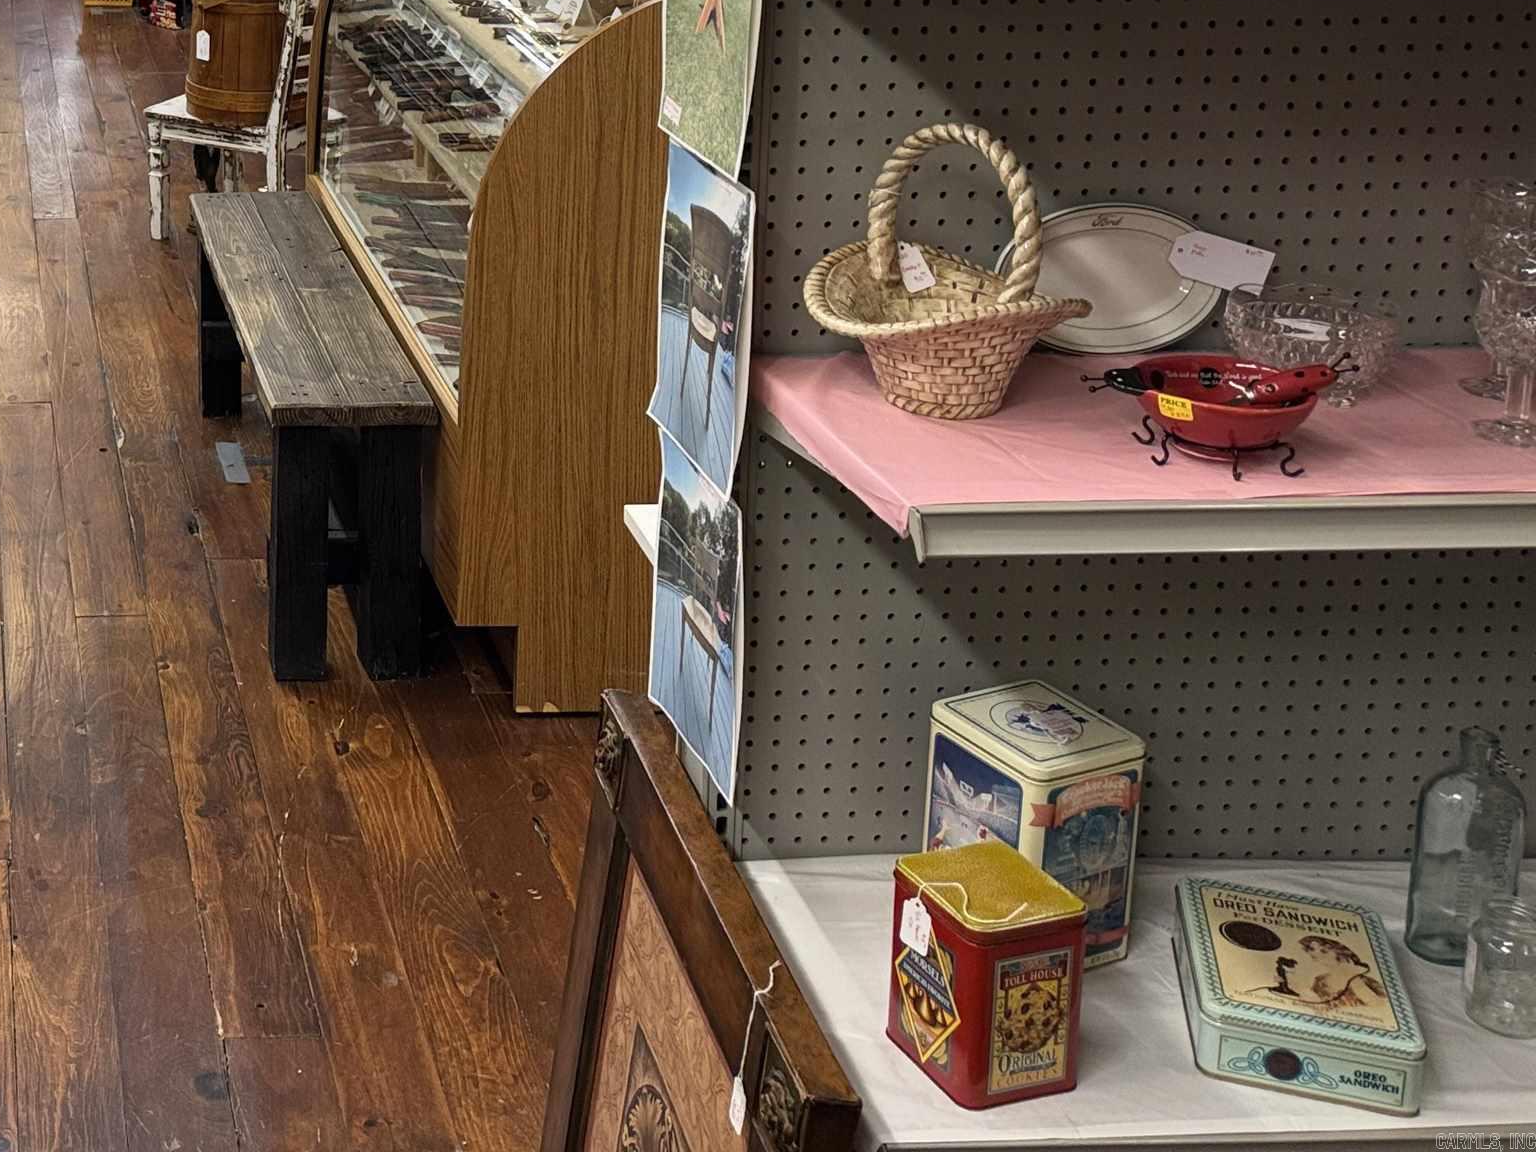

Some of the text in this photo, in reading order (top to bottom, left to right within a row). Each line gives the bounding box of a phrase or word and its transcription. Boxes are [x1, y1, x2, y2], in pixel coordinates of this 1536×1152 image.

[1092, 214, 1123, 227] Ford
[1160, 397, 1188, 410] PRICE
[1214, 898, 1360, 933] OREO SANDWICH
[1004, 967, 1064, 988] TOLL HOUSE
[998, 1049, 1057, 1074] ORIGINAL
[997, 1069, 1058, 1088] COOKIES
[1338, 1075, 1400, 1095] SANDWICH
[1354, 1069, 1388, 1083] OREO
